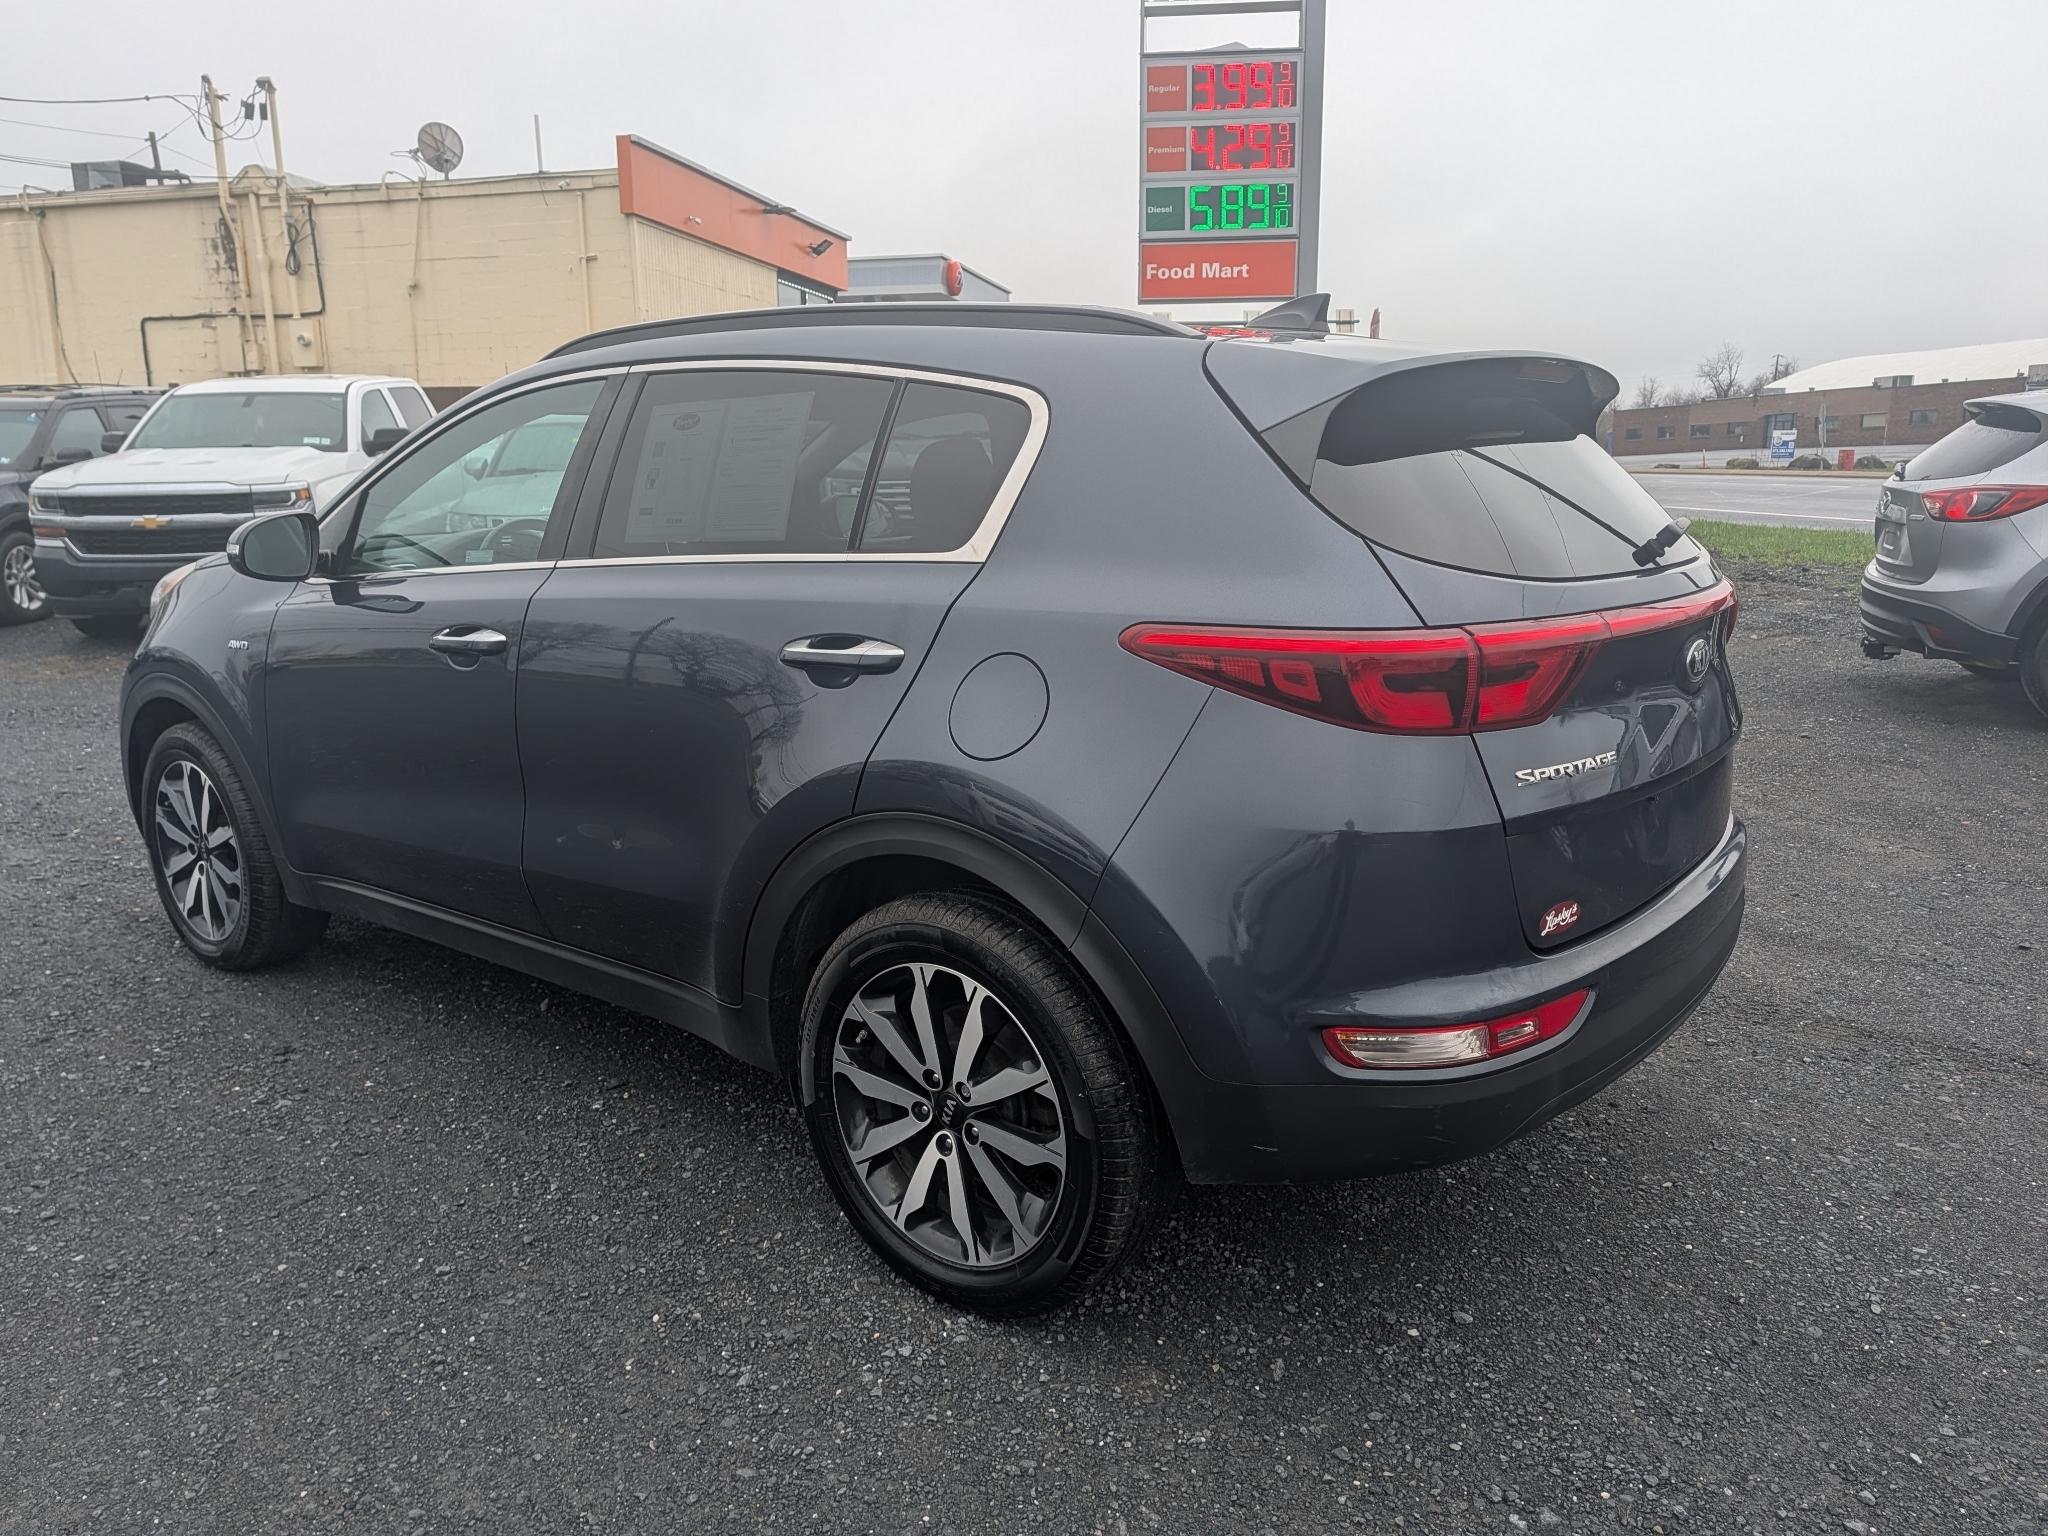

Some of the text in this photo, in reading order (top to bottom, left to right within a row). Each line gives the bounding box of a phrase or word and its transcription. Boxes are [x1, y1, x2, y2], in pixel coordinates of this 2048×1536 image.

[1148, 84, 1180, 93] Regular
[1193, 62, 1273, 111] 3.99
[1148, 145, 1185, 154] Premium
[1190, 123, 1272, 170] 4.29
[1147, 206, 1173, 214] Diesel
[1190, 184, 1270, 231] 5.89
[1146, 262, 1250, 280] Food Mart
[228, 639, 249, 650] AWD
[1515, 750, 1617, 787] SPORTAGE
[941, 1099, 957, 1125] KIA
